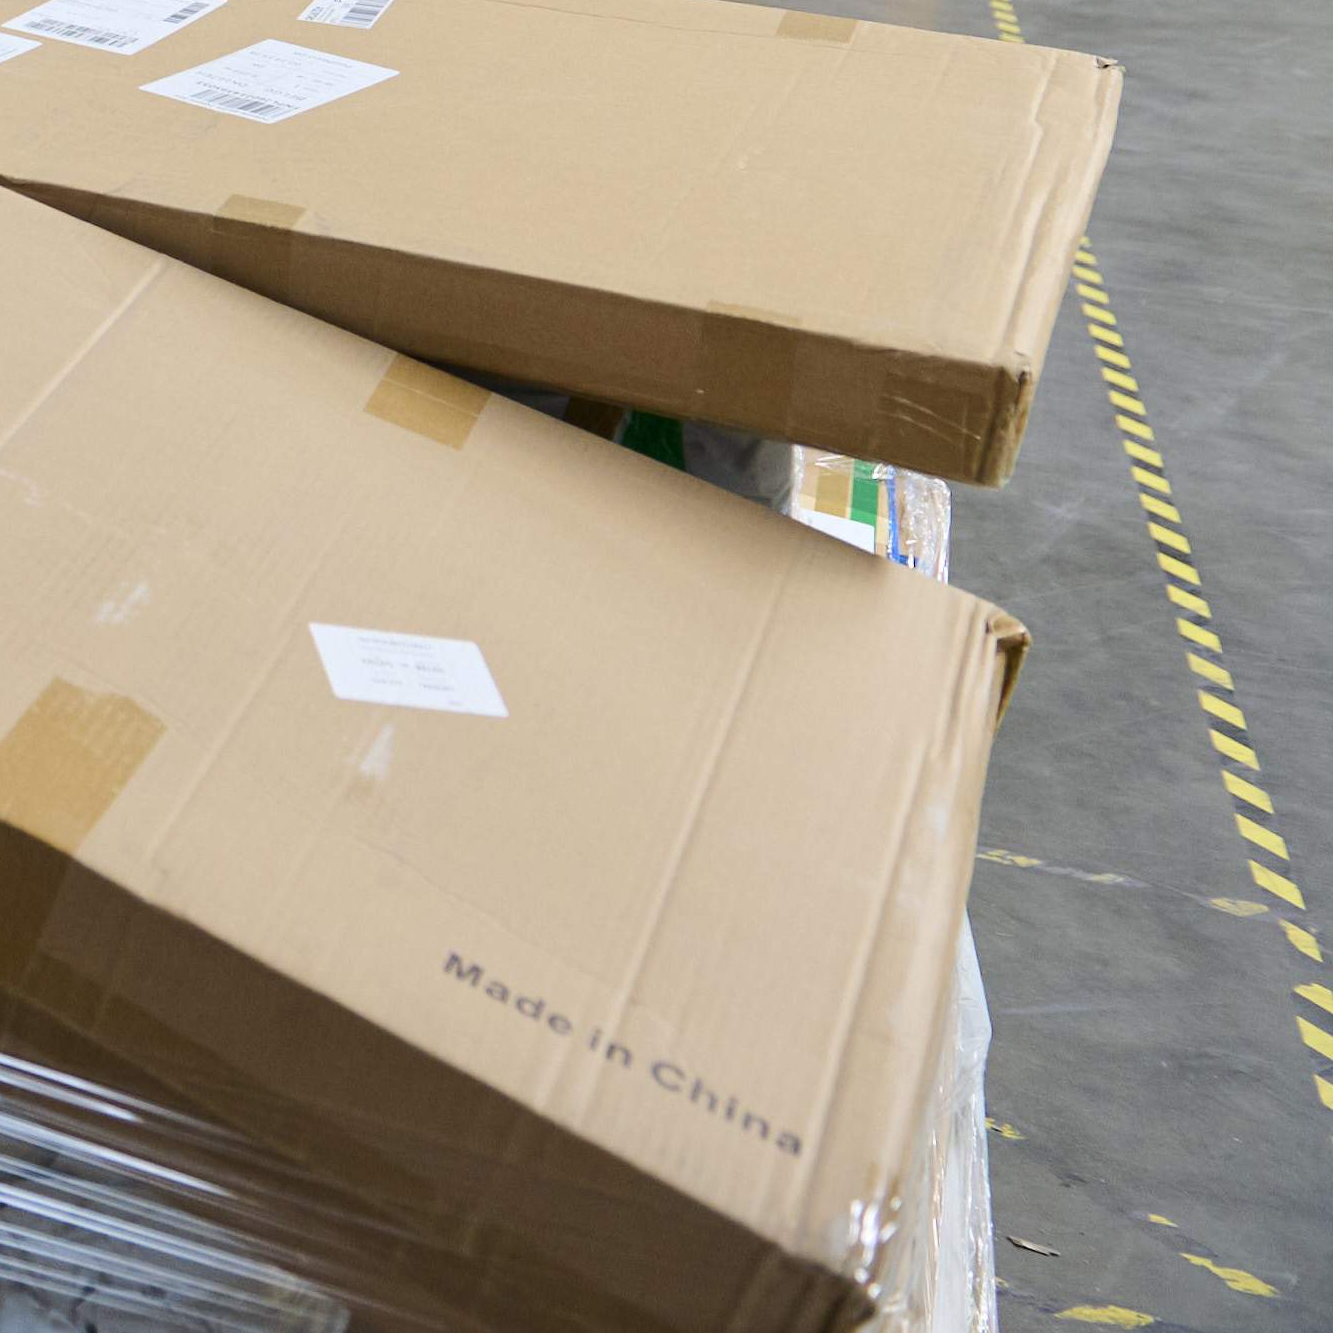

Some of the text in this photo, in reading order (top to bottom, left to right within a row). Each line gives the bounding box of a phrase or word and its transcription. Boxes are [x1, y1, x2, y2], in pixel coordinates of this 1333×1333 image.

[442, 951, 803, 1157] Made in China
